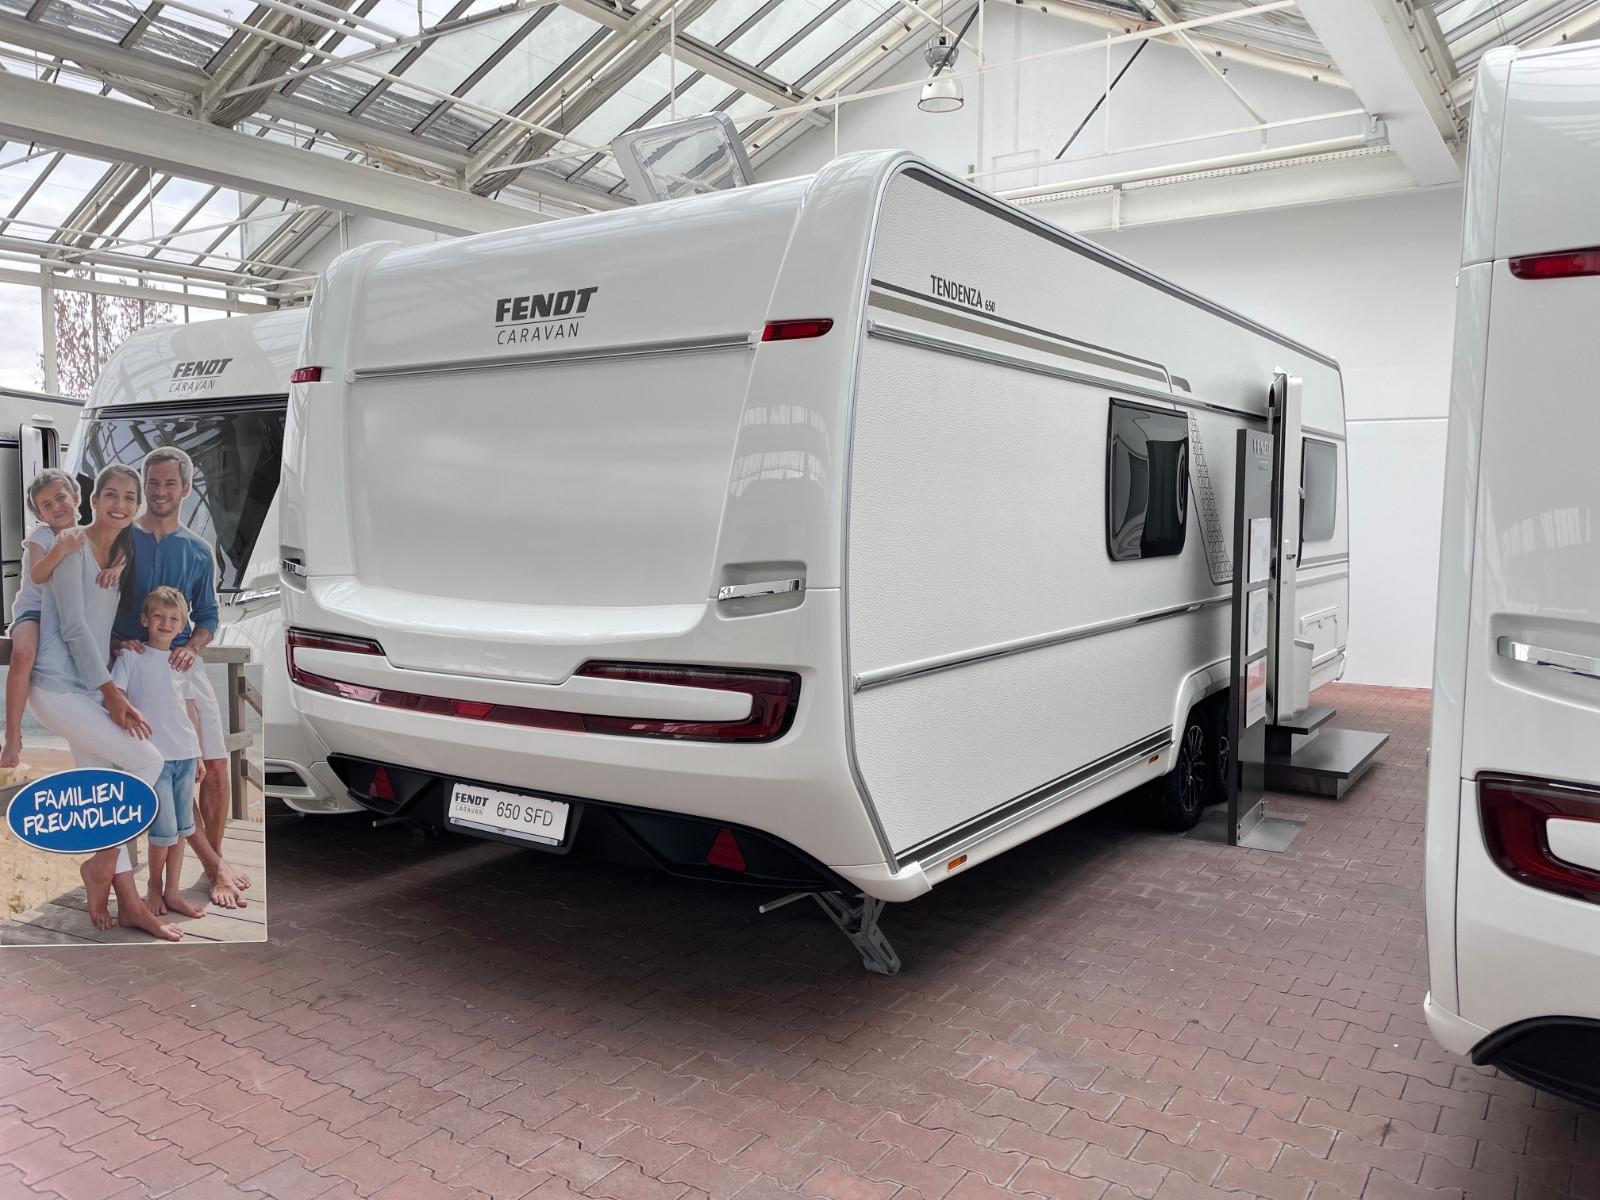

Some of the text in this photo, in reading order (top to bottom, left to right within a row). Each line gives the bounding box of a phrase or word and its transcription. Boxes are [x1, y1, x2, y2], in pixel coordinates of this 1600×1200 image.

[495, 286, 599, 322] FENDT
[930, 274, 996, 312] TENDENZA 650
[497, 322, 579, 345] CARAVAN
[172, 358, 233, 378] FENDT
[168, 379, 216, 393] CARAVAN
[34, 781, 124, 811] FAMILIEN
[455, 792, 489, 807] FENDT
[23, 804, 142, 836] FREUNDLICH
[455, 803, 484, 816] CARAVAN
[496, 801, 554, 827] 650 SFD
